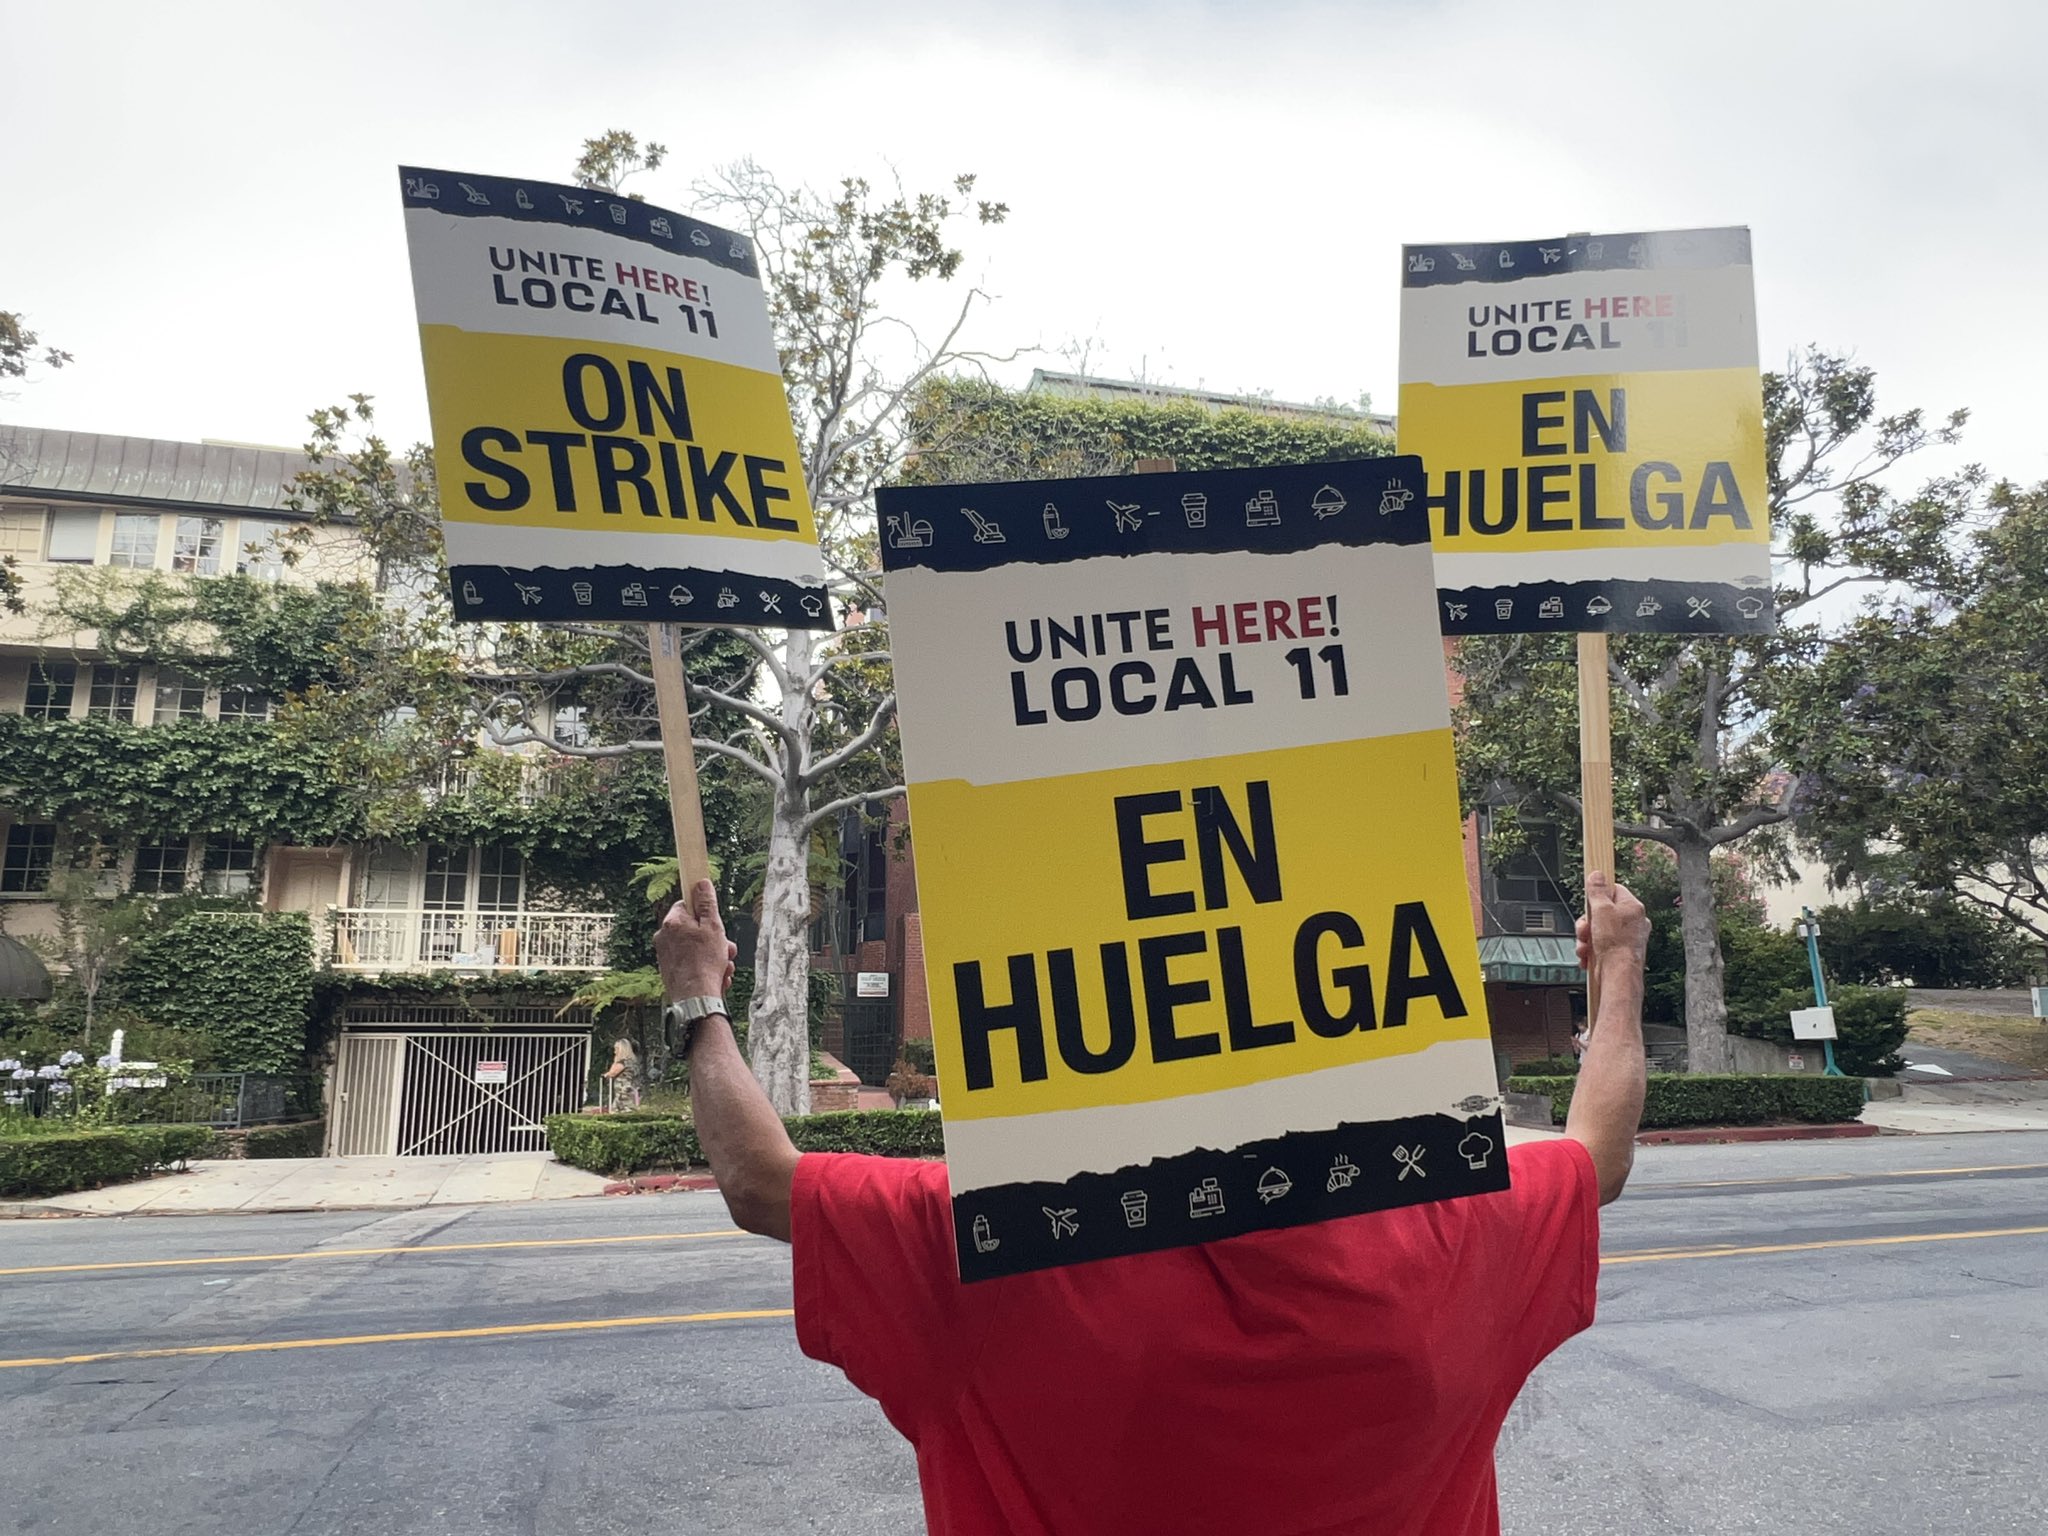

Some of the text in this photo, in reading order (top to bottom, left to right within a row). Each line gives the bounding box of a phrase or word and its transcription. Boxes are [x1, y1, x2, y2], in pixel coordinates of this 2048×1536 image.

[489, 246, 710, 306] UNITE HERE!
[494, 274, 719, 339] LOCAL 11
[1467, 321, 1621, 358] LOCAL
[1468, 294, 1687, 328] UNITE HERE
[562, 353, 694, 442] ON
[1522, 388, 1627, 457] EN
[461, 427, 800, 533] STRIKE
[1005, 595, 1341, 664] UNITE HERE!
[1011, 644, 1349, 727] LOCAL 11
[1114, 780, 1283, 921] EN
[953, 901, 1468, 1092] HUELGA
